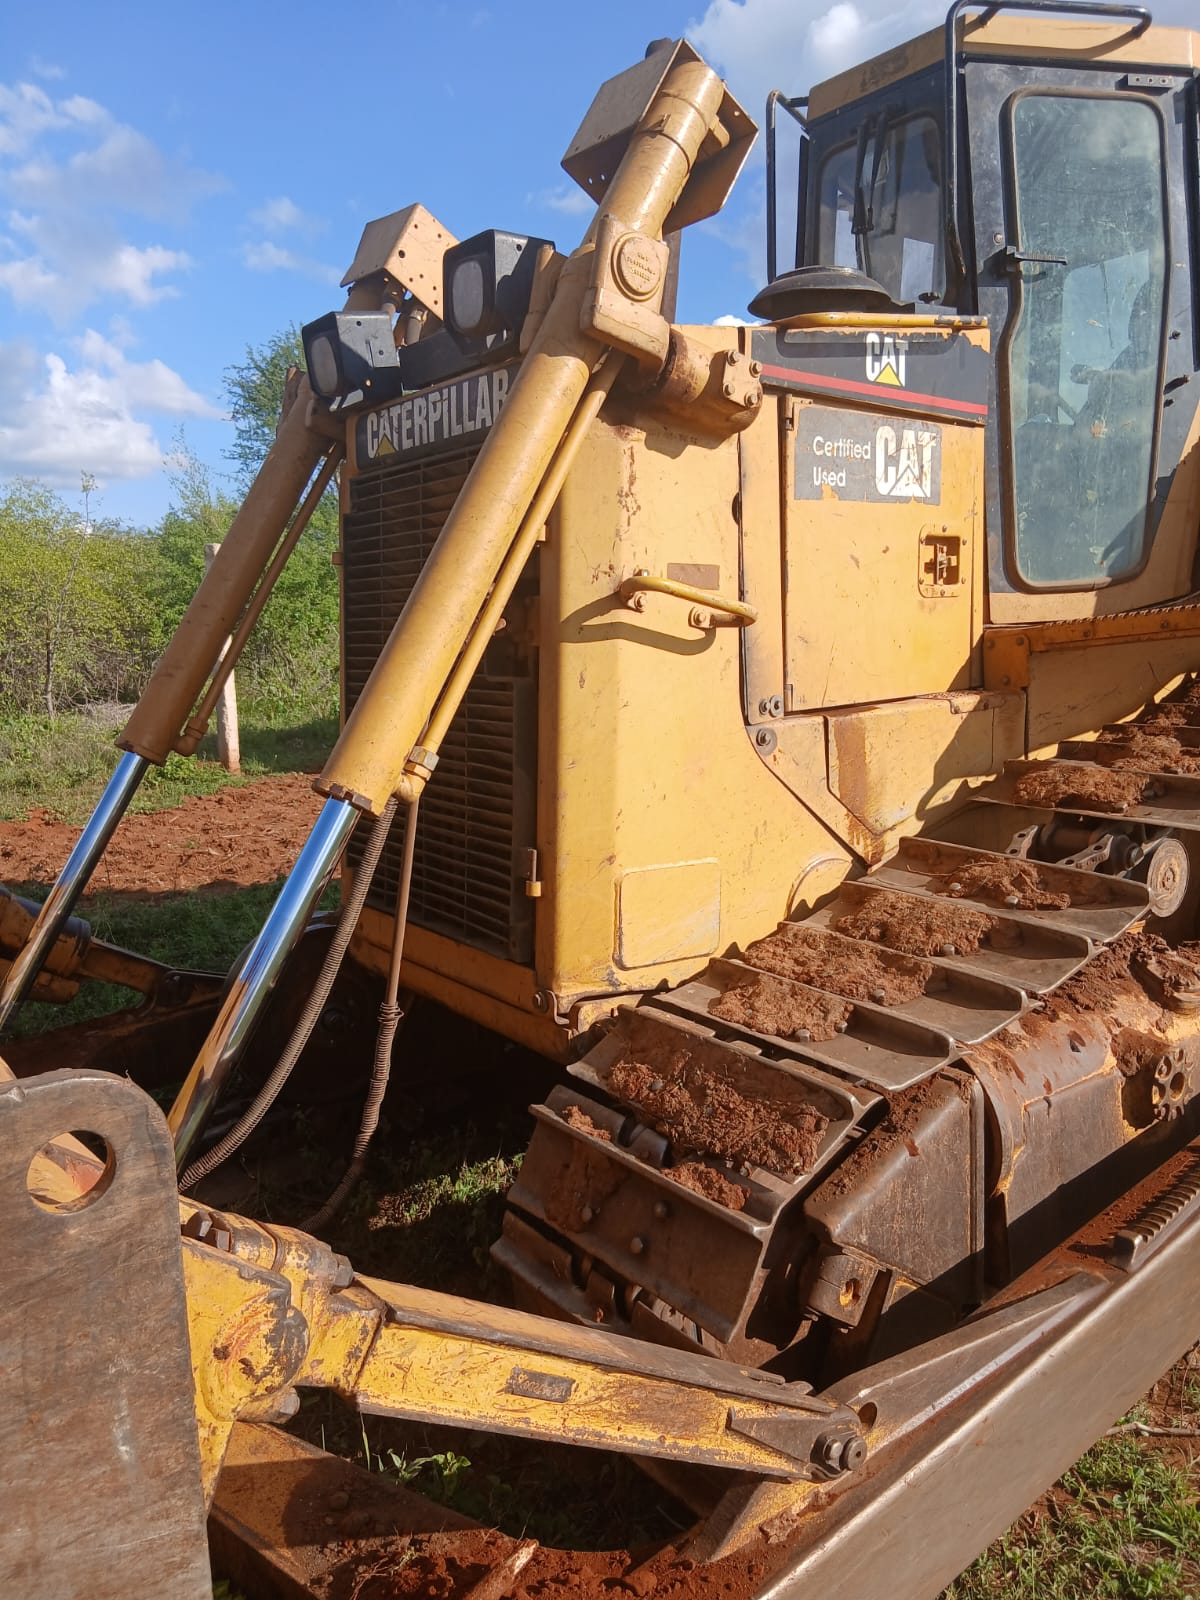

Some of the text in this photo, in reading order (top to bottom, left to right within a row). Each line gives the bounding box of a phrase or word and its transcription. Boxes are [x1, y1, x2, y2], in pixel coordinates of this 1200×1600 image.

[866, 332, 909, 387] CAT
[366, 369, 509, 459] CATERPILLAR
[813, 435, 871, 459] Certified
[875, 426, 937, 498] CAT
[813, 466, 846, 487] Used
